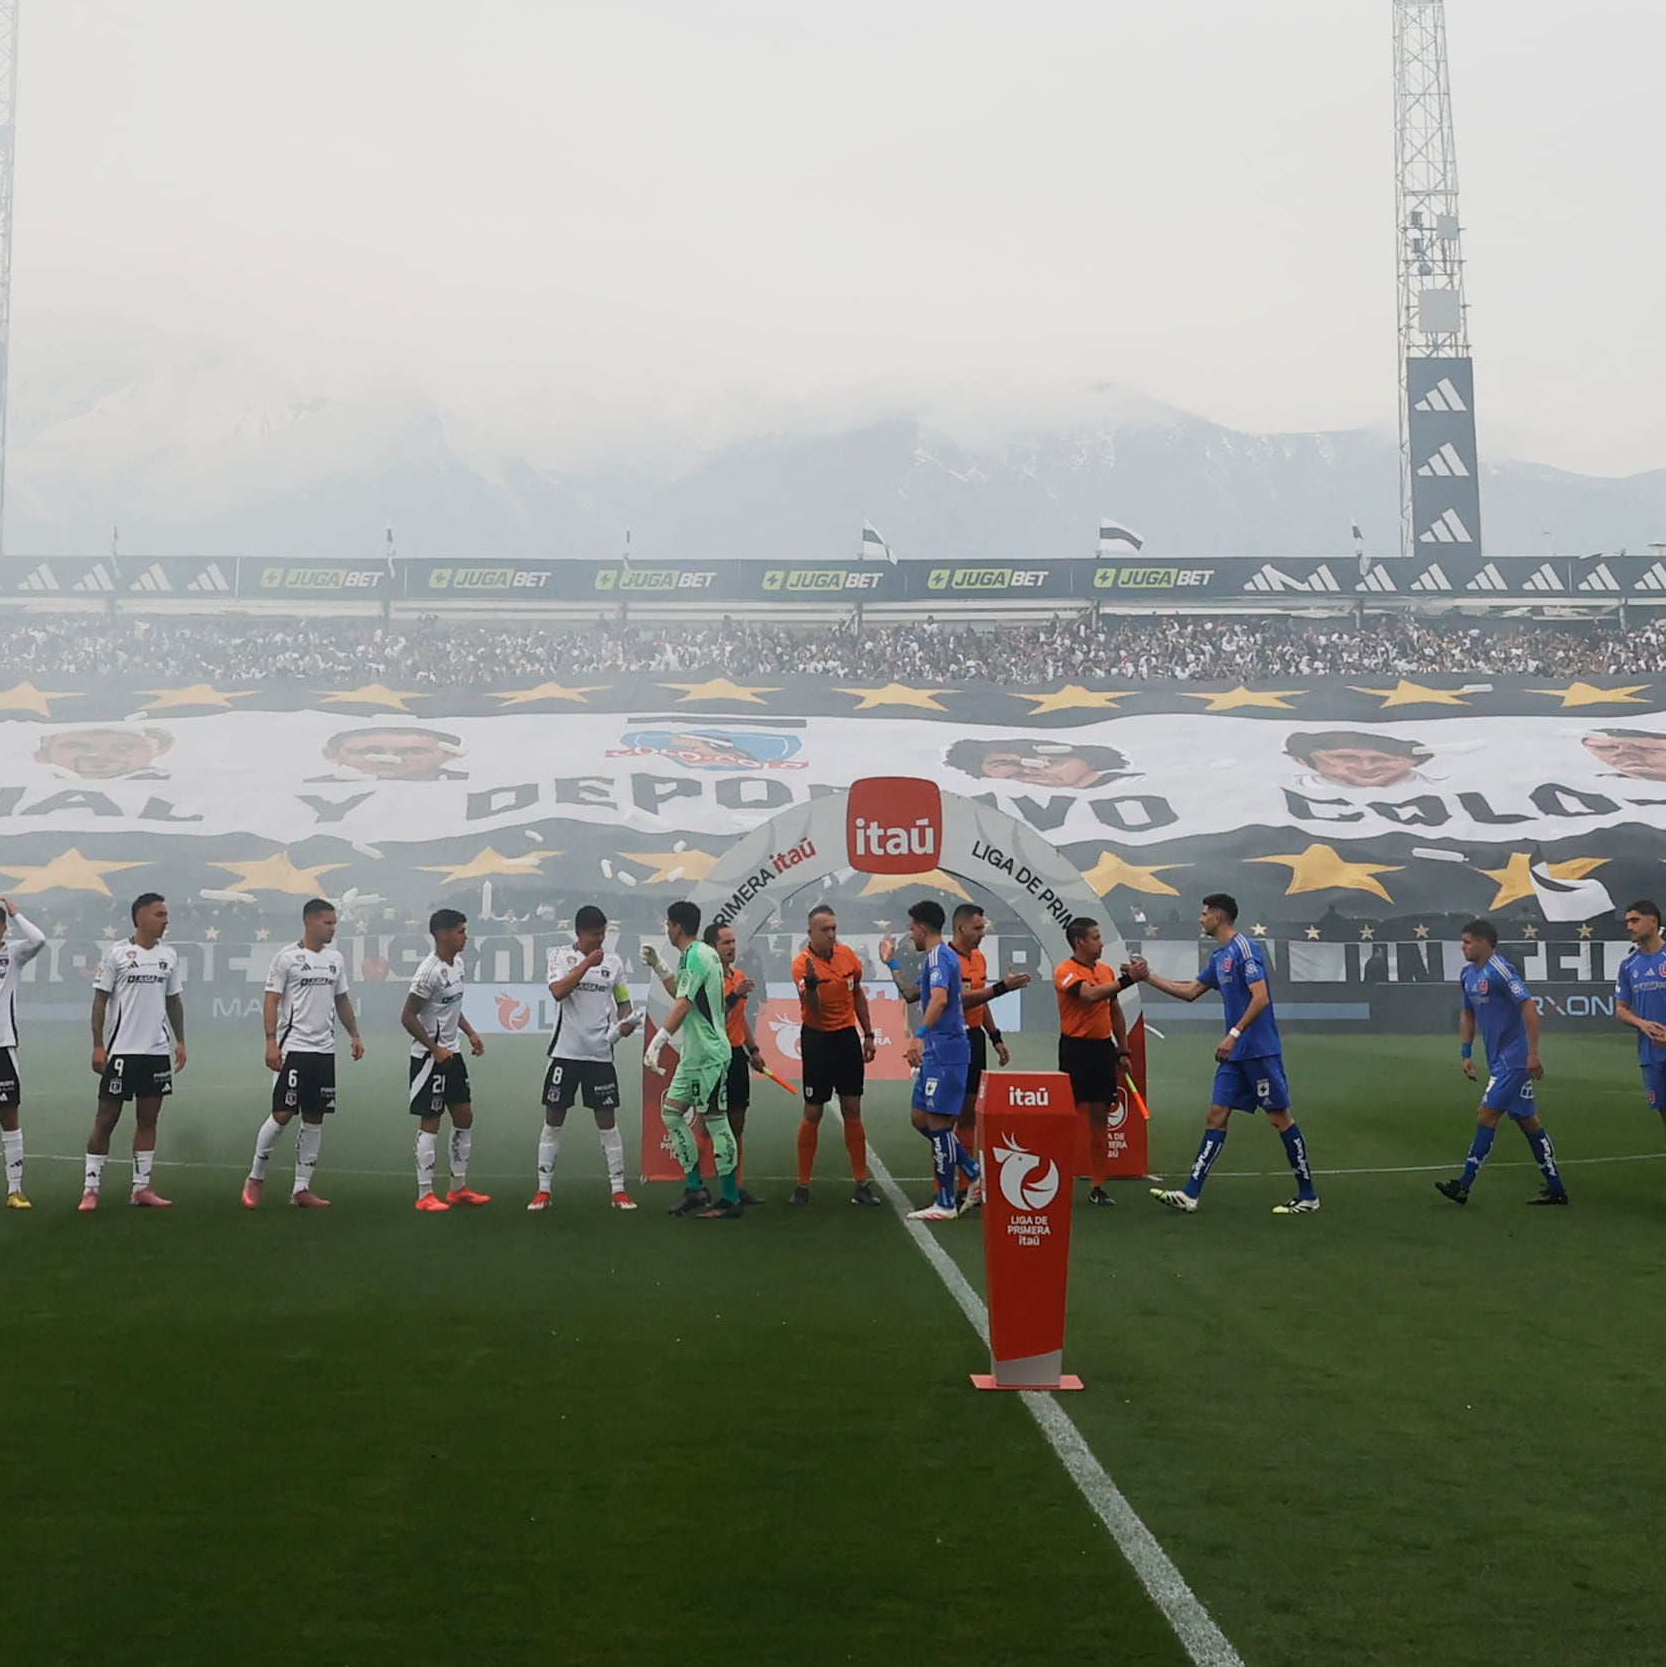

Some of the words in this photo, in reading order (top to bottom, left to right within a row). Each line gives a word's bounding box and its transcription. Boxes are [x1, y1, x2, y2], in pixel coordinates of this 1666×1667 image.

[294, 788, 379, 823] Y
[466, 772, 1179, 832] DEPOVO
[854, 817, 935, 856] itaú
[971, 840, 1015, 876] LIGA
[1015, 866, 1044, 895] DE
[713, 868, 776, 927] RIMERA
[769, 837, 817, 874] itaú
[114, 1058, 125, 1077] 9
[552, 1066, 563, 1085] 8
[288, 1069, 298, 1087] 6
[432, 1074, 446, 1093] 21
[1008, 1086, 1050, 1106] itaú
[1010, 1216, 1033, 1225] LIGA
[1035, 1216, 1048, 1225] DE
[1007, 1226, 1051, 1235] PRIMERA
[1018, 1235, 1040, 1246] itaú
